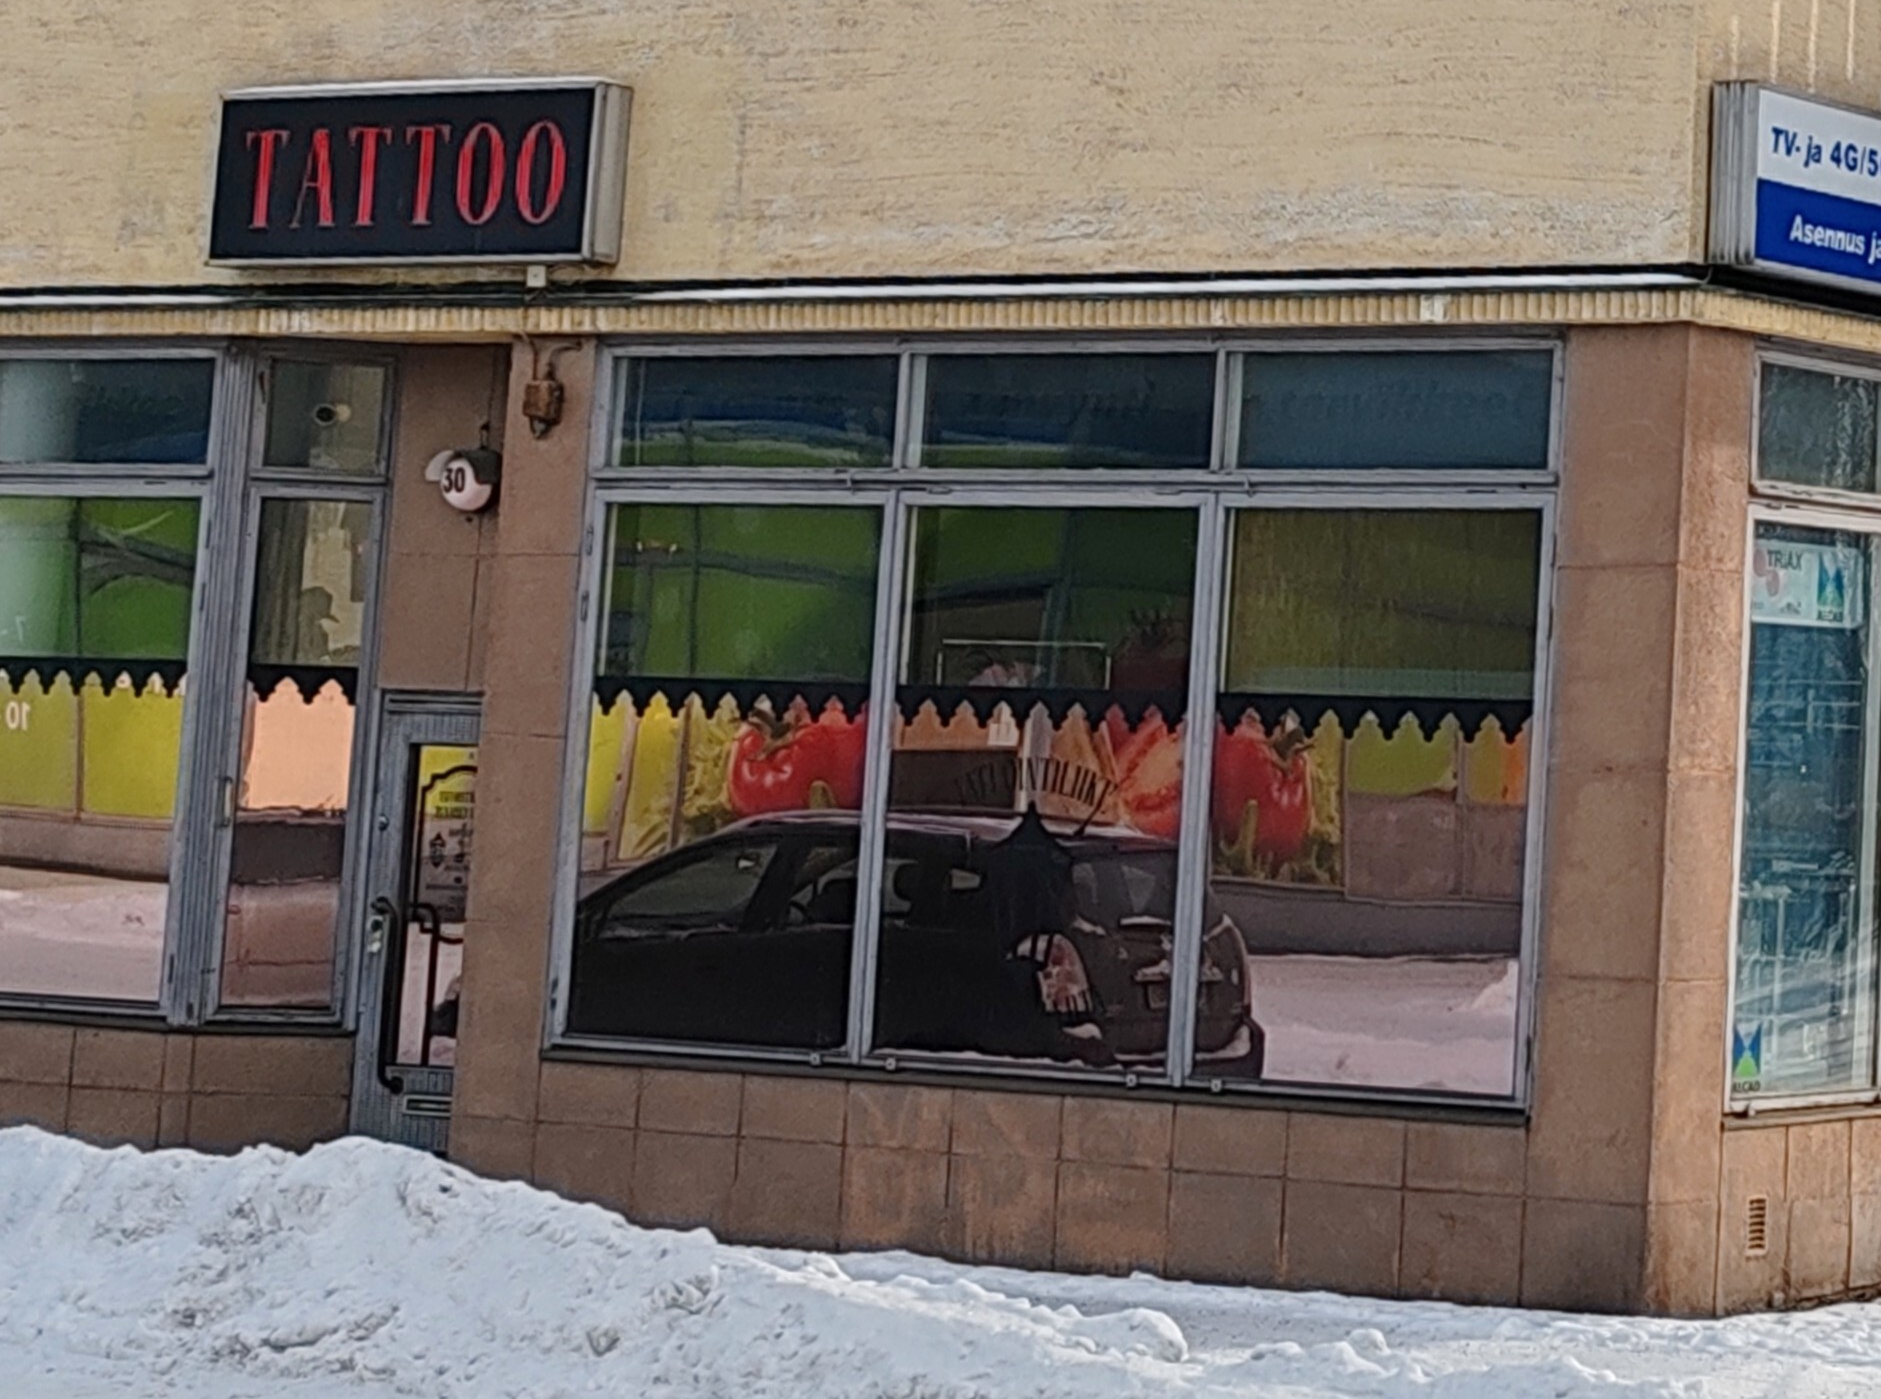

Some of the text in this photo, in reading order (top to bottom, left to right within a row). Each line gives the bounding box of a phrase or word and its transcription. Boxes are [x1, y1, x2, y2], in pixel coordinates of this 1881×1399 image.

[1771, 126, 1801, 157] TV-
[1803, 135, 1822, 168] ja
[245, 121, 566, 229] TATTOO
[1789, 214, 1865, 256] Asennus
[443, 466, 466, 493] 30
